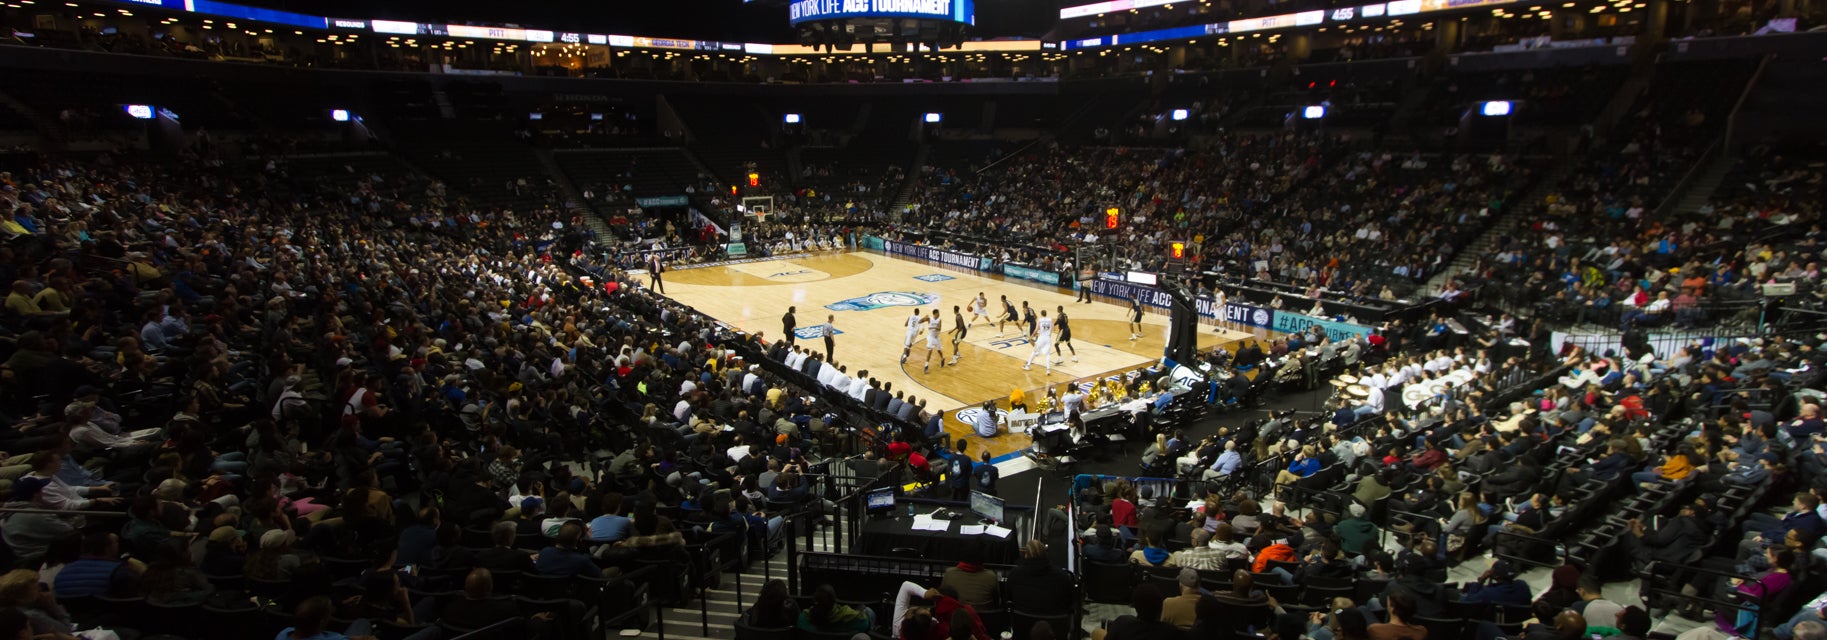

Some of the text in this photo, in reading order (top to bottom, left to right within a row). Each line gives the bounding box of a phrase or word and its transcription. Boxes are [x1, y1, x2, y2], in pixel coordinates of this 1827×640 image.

[790, 0, 950, 19] NEW YORK LIFE ACC TOURNAMENT
[1331, 8, 1354, 20] 4:55
[1262, 18, 1276, 27] PITT
[488, 29, 504, 37] PITT
[561, 33, 579, 42] 4:55
[892, 242, 980, 268] NEW YORK LIFE ACC TOURNAMENT
[1108, 282, 1130, 297] YORK
[1152, 291, 1172, 307] ACC
